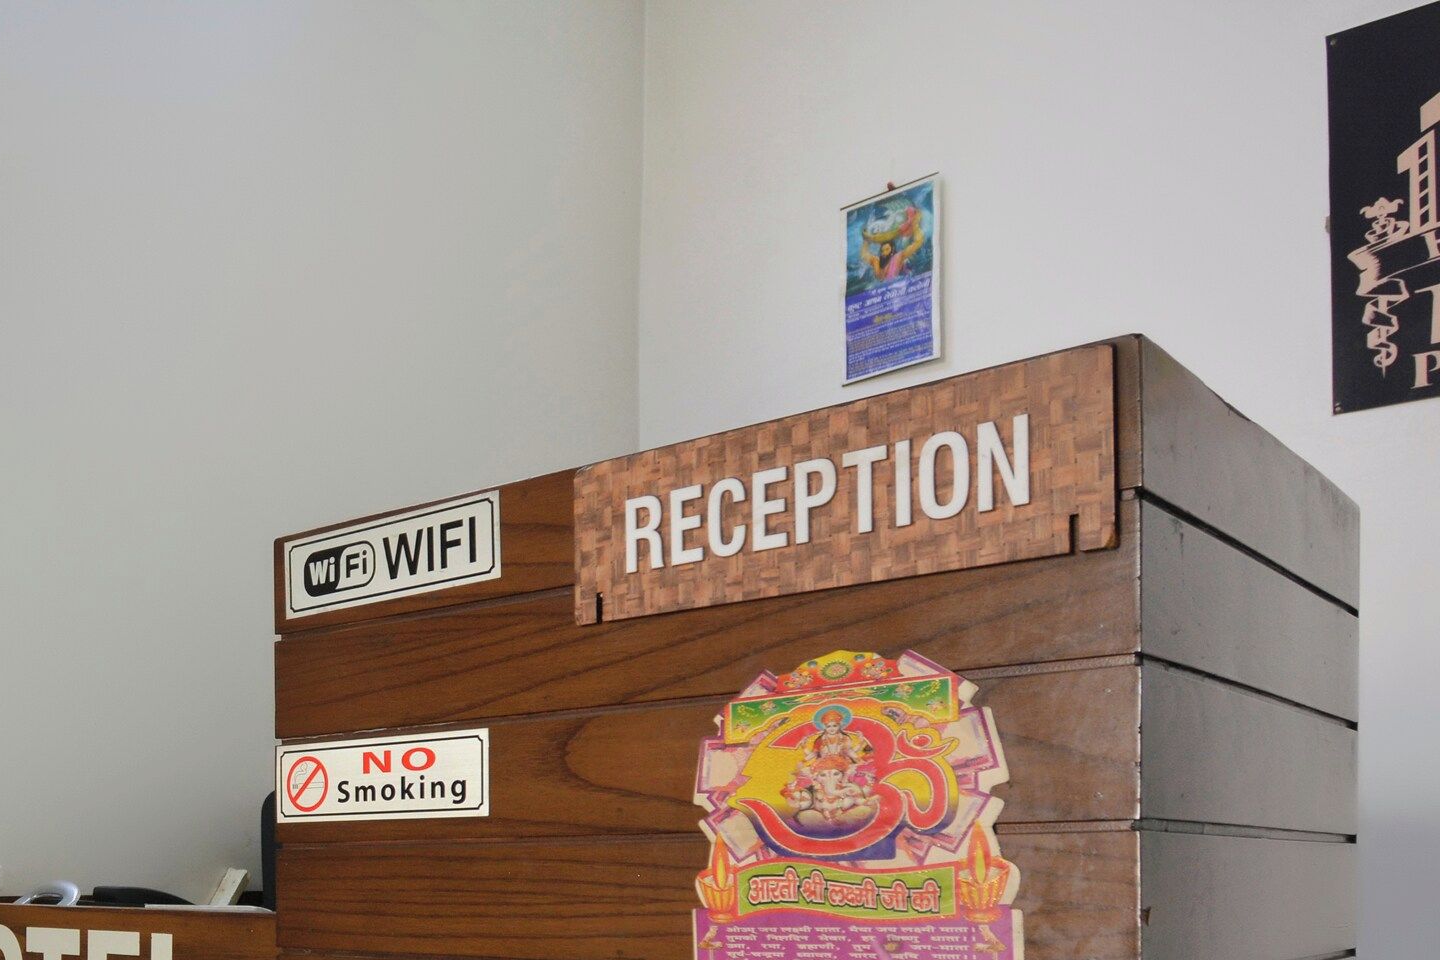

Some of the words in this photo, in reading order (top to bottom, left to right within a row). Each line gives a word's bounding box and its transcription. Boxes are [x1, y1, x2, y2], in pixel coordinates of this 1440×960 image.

[625, 413, 1031, 575] RECEPTION
[382, 516, 477, 580] WIFI
[362, 747, 436, 774] NO
[337, 775, 467, 804] Smoking
[749, 866, 799, 904] आरती
[801, 869, 826, 904] श्री
[827, 878, 878, 909] लक्ष्मी
[880, 879, 908, 911] जी
[910, 879, 941, 913] की
